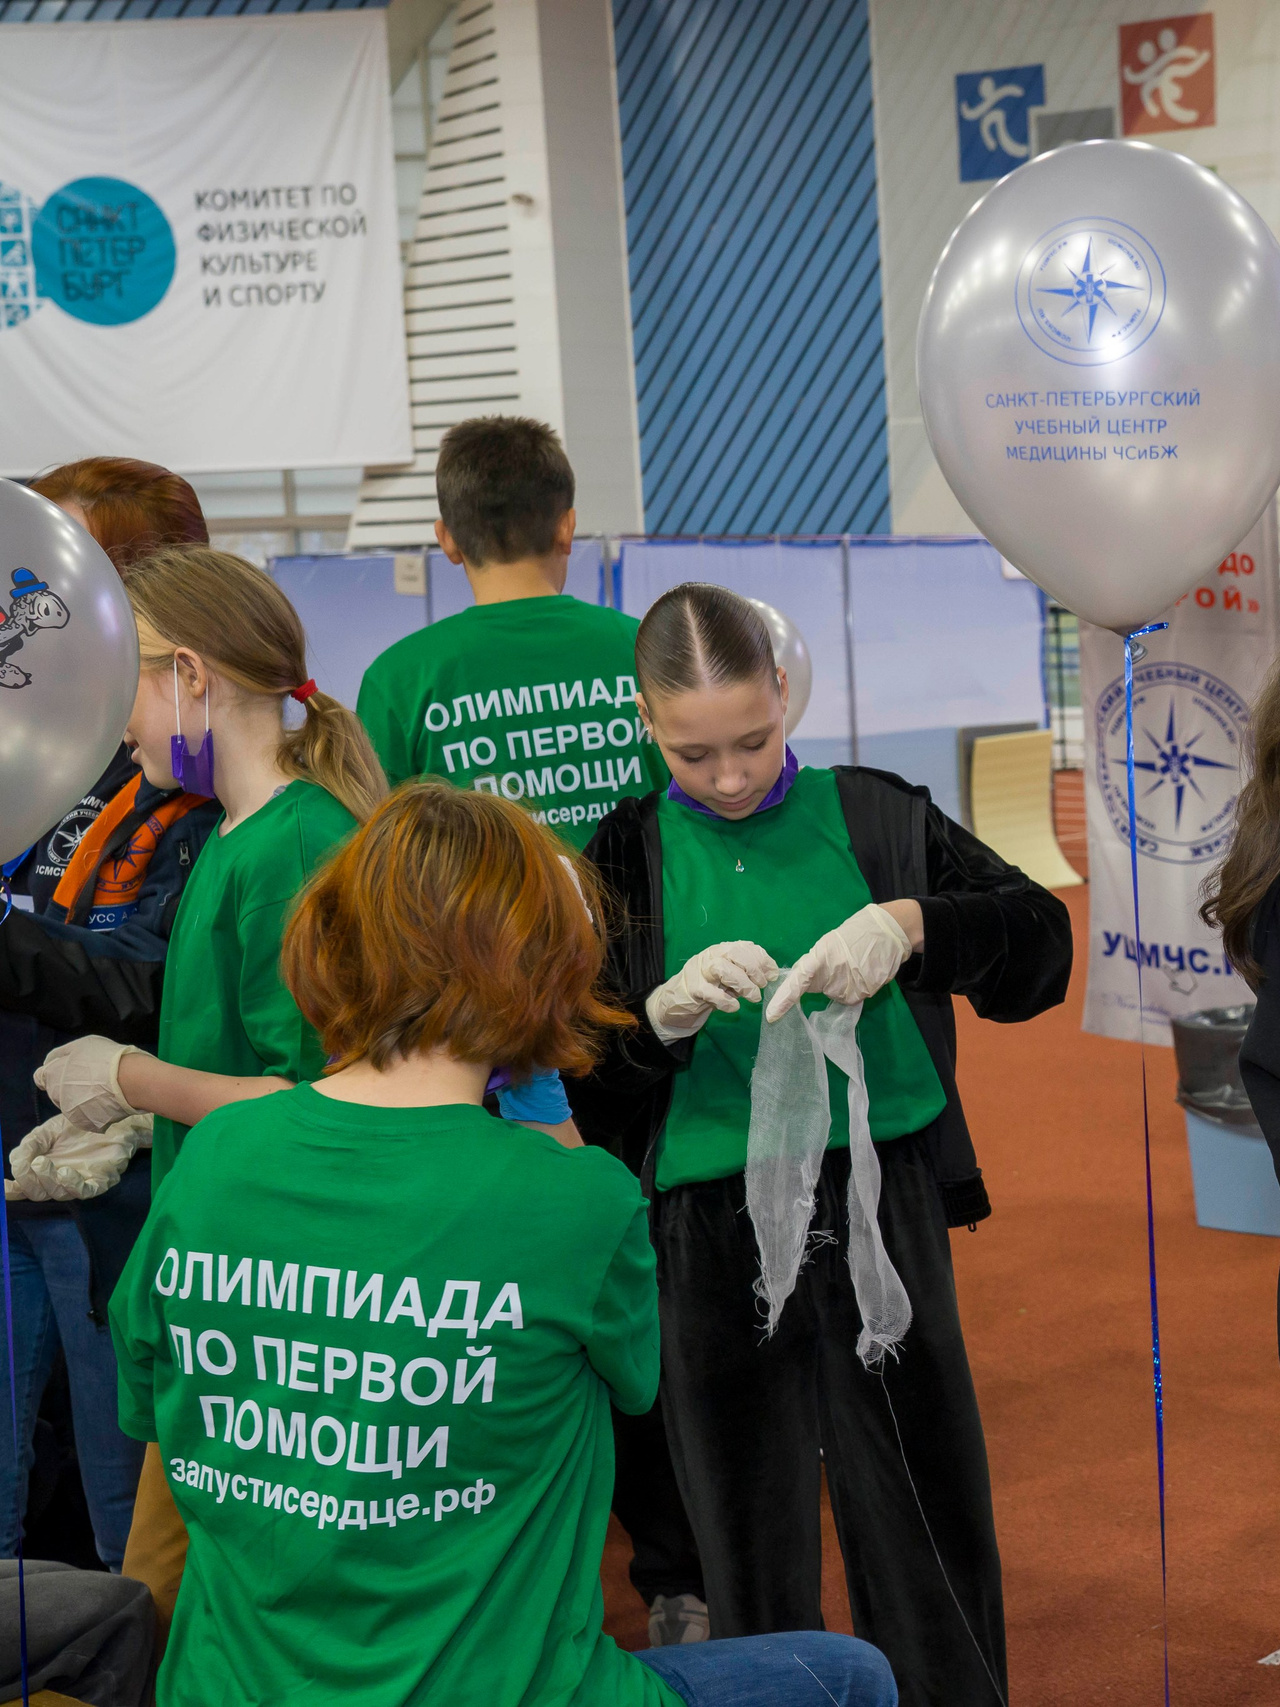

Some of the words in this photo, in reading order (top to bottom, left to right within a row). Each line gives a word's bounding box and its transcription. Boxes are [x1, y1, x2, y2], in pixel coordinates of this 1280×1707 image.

[195, 186, 313, 212] КОМИТЕТ
[321, 182, 358, 207] ПО
[196, 212, 368, 243] ФИЗИЧЕСКОЙ
[201, 250, 319, 276] КУЛЬТУРЕ
[204, 287, 222, 309] И
[227, 281, 327, 308] СПОРТУ
[985, 388, 1201, 409] САНКТ-ПЕТЕРБУРГСКИЙ
[1014, 415, 1101, 435] УЧЕБНЫЙ
[1107, 418, 1168, 436] ЦЕНТР
[1005, 445, 1107, 463] МЕДИЦИНЫ
[1113, 444, 1179, 461] ЧСиБЖ
[425, 675, 638, 733] ОЛИМПИАД
[442, 736, 497, 774] ПО
[474, 755, 642, 801] ПОМОЩИ
[1102, 929, 1233, 976] УЦМЧС.
[155, 1247, 524, 1340] ОЛИМПИАДА
[168, 1324, 237, 1376] ПО
[252, 1335, 497, 1407] ПЕРВОЙ
[199, 1395, 450, 1480] ПОМОЩИ
[169, 1457, 497, 1531] запустисердце.рф
